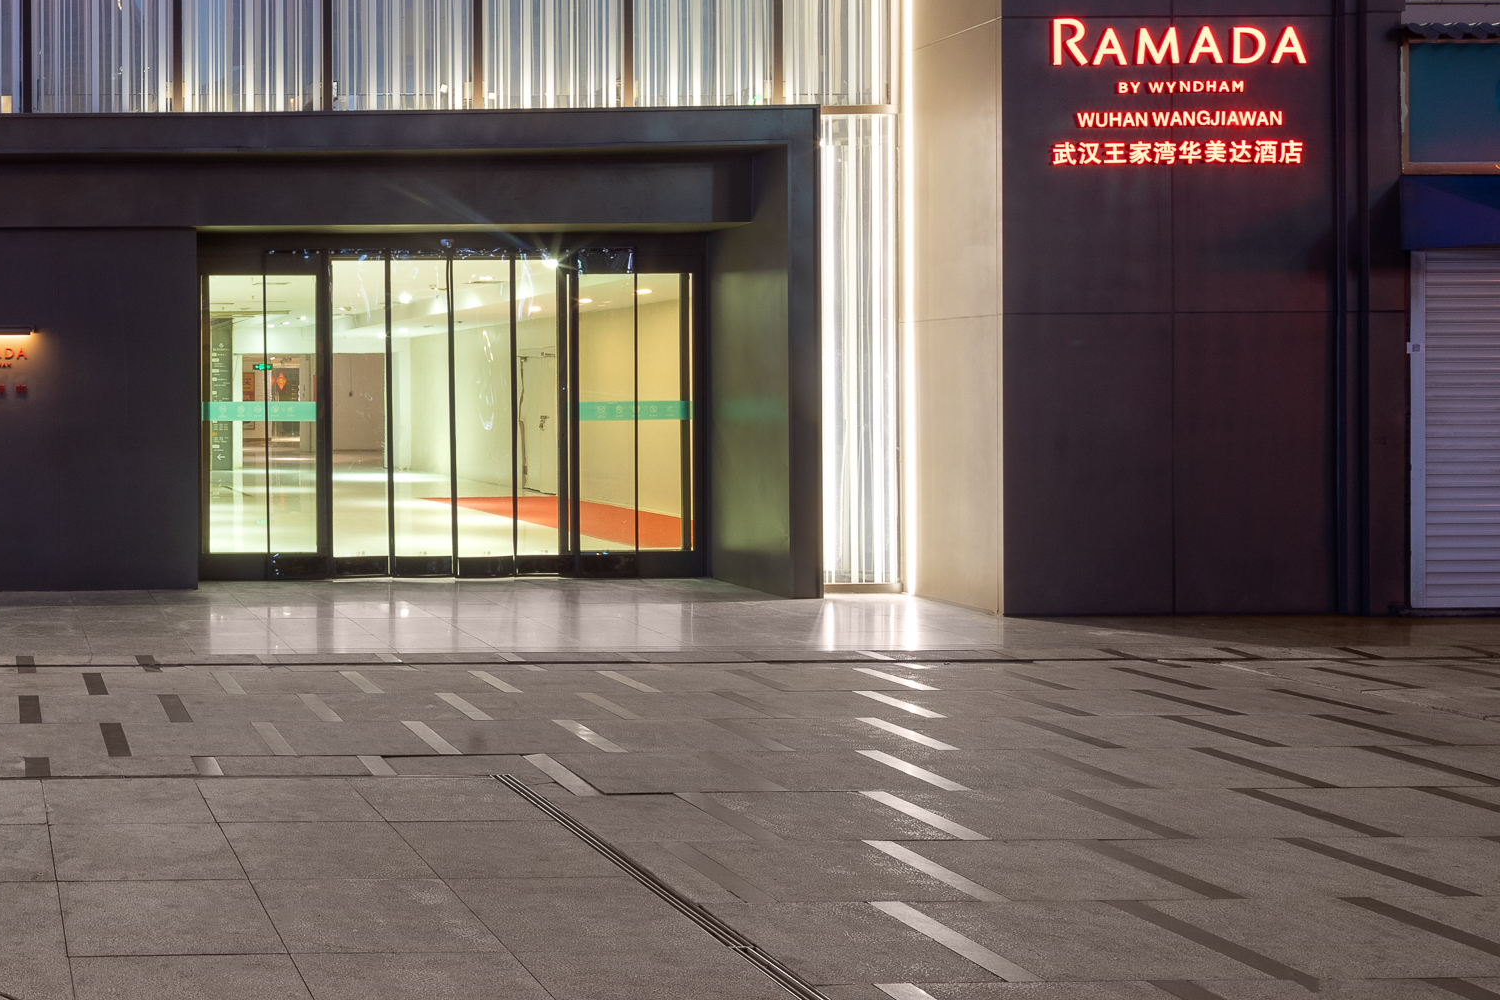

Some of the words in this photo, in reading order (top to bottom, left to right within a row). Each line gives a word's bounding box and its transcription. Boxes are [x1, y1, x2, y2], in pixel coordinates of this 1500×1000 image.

[1052, 17, 1307, 66] RAMADA
[1117, 81, 1141, 94] BY
[1148, 80, 1245, 93] WYNDHAM
[1076, 112, 1148, 127] WUHAN
[1152, 110, 1283, 127] WANGJIAWAN
[1052, 140, 1304, 165] 武汉王家湾华美达酒店
